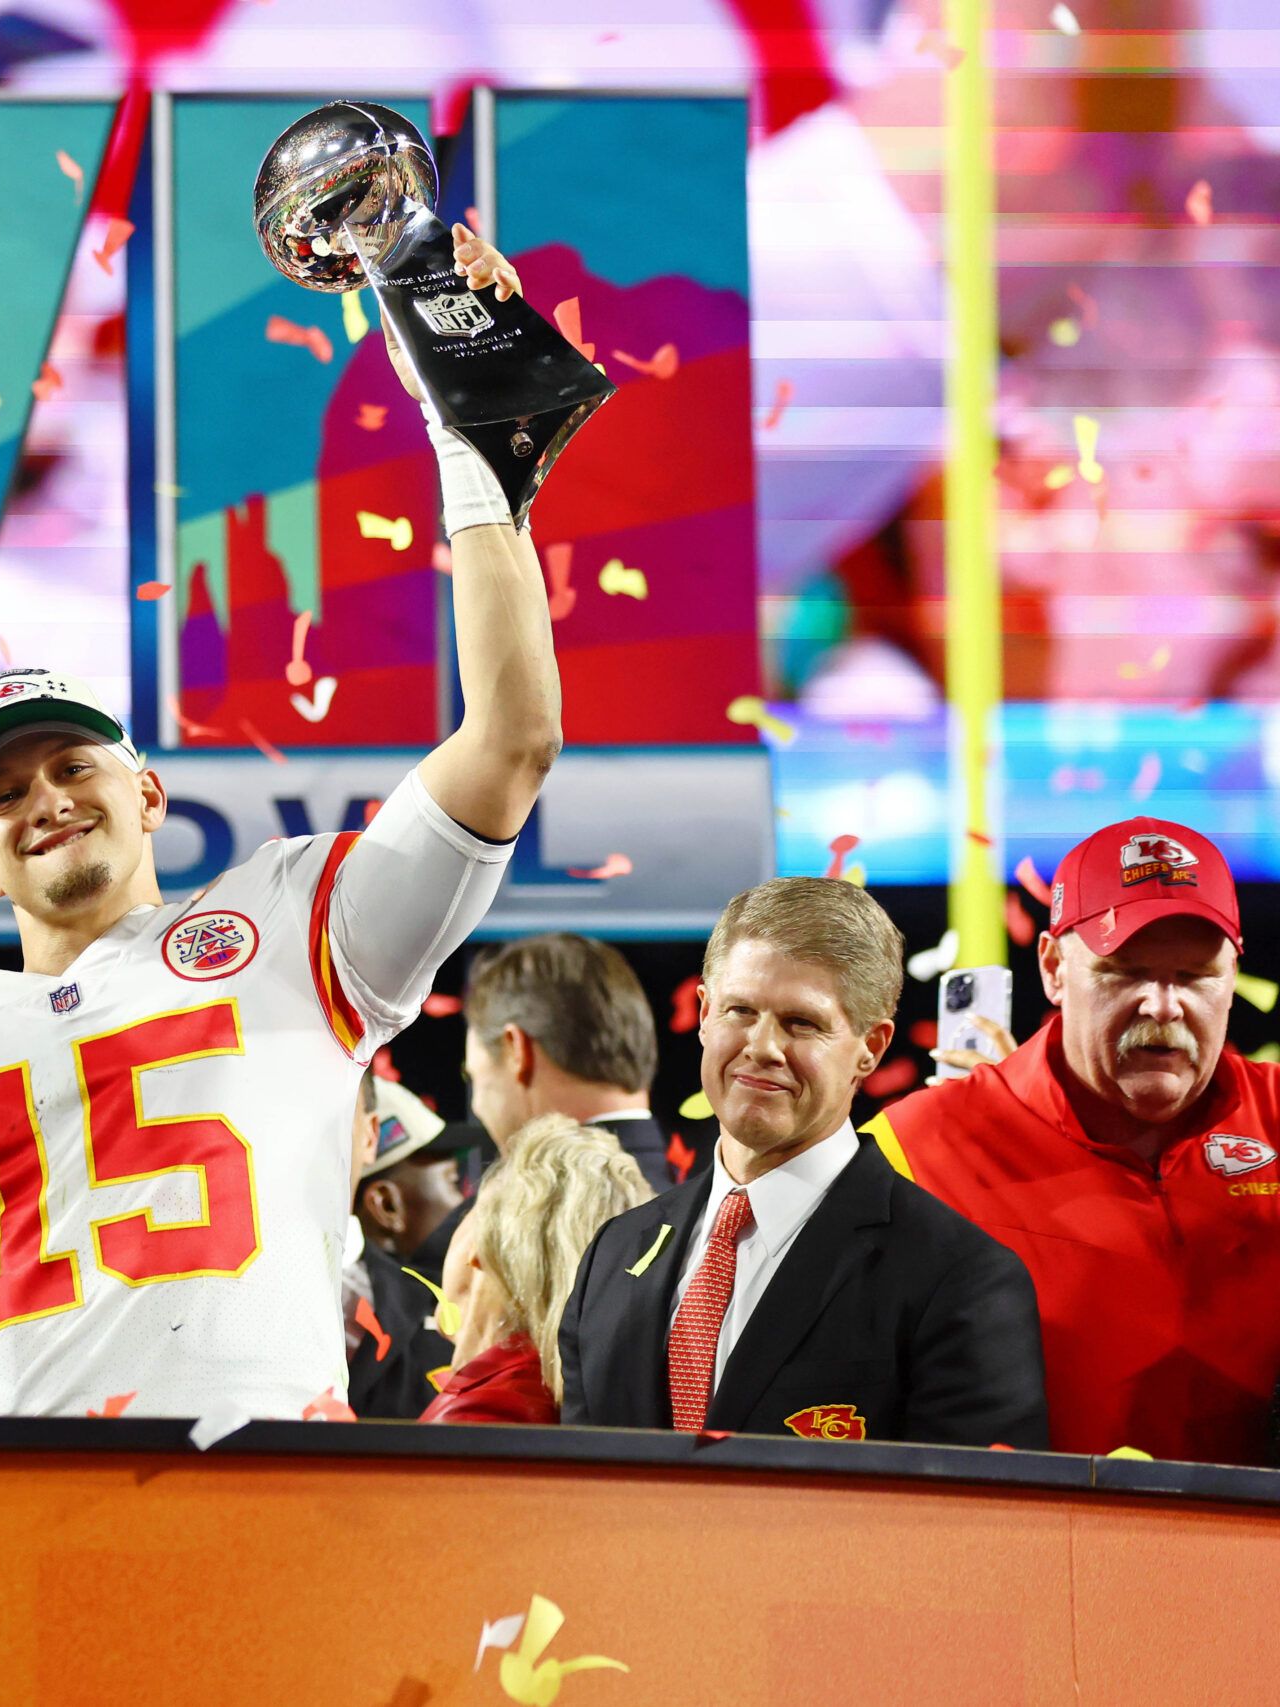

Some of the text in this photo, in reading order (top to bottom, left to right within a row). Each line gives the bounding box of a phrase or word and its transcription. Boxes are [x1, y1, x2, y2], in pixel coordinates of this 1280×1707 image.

[417, 268, 457, 284] LOMBA
[412, 279, 457, 295] TROPHY
[433, 306, 487, 331] NFL
[1138, 840, 1183, 863] KC
[1122, 862, 1169, 883] CHIEFS
[1172, 870, 1191, 881] AFC
[55, 993, 79, 1011] NFL
[1220, 1141, 1264, 1164] KC
[1229, 1182, 1280, 1197] CHIEF
[810, 1410, 851, 1440] KC
